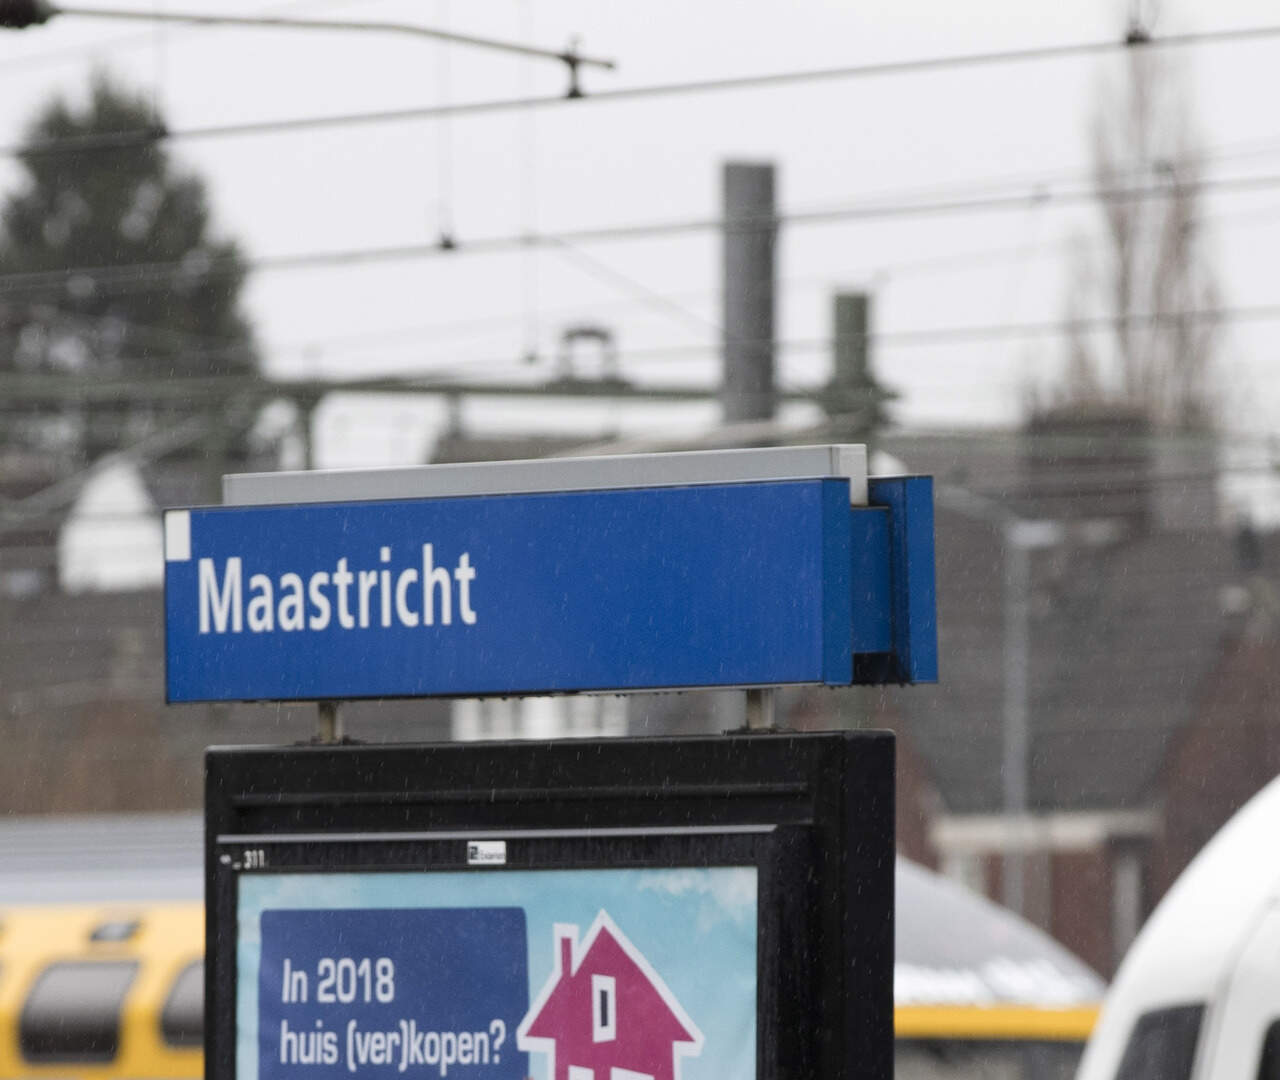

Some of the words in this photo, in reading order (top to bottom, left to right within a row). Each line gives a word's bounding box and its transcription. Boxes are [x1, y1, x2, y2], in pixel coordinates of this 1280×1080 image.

[197, 542, 478, 635] Maastricht
[281, 957, 309, 1004] In
[316, 956, 396, 1004] 2018
[279, 1018, 339, 1066] huis
[345, 1017, 507, 1078] (ver)kopen?
